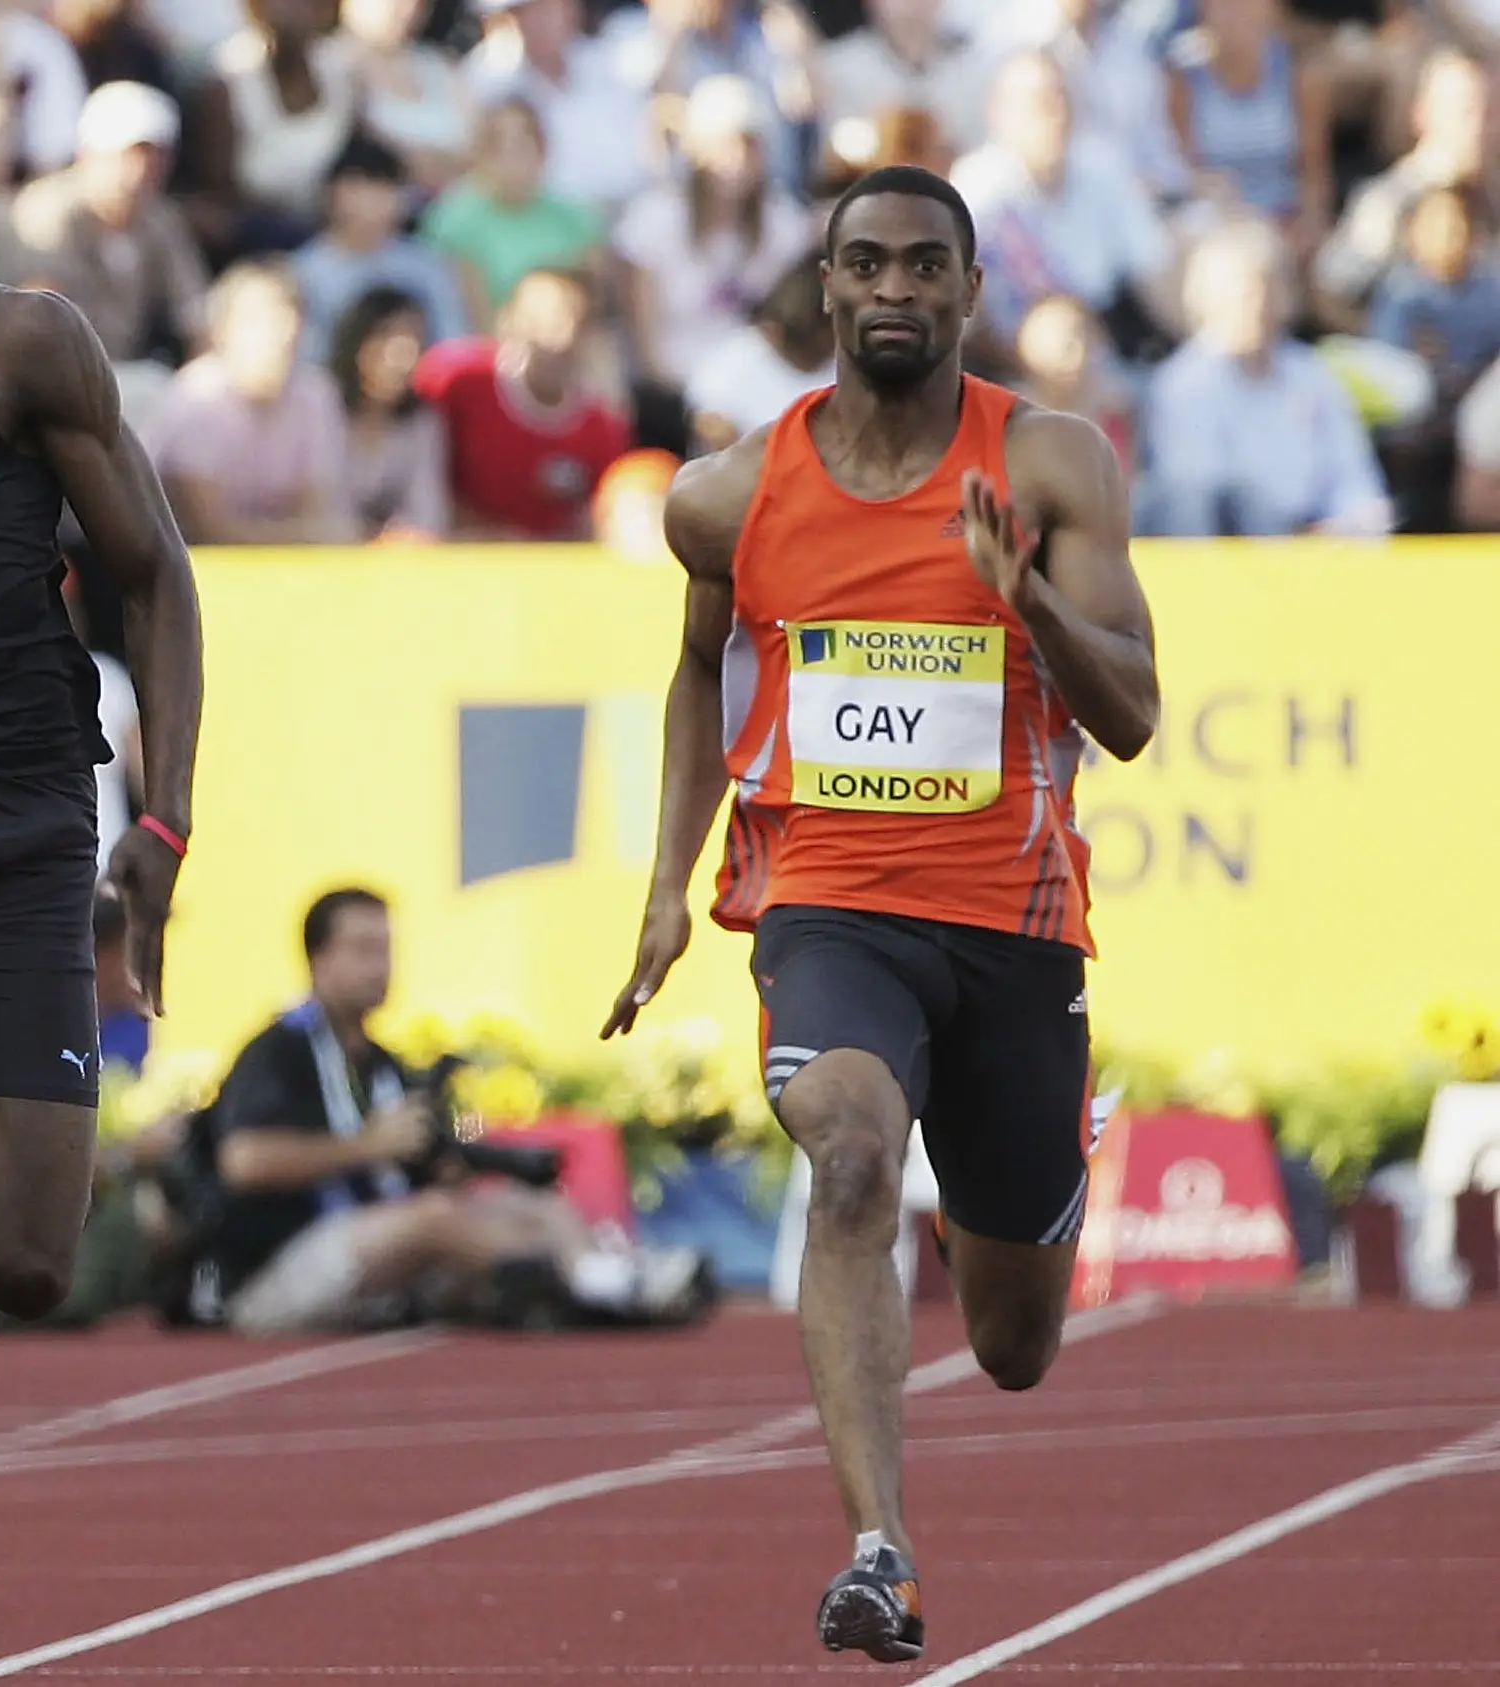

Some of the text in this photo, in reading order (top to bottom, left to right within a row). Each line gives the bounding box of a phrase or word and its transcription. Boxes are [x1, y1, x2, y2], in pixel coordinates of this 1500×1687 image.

[844, 630, 987, 654] NORWICH
[865, 652, 962, 674] UNION
[835, 702, 925, 744] GAY
[819, 771, 968, 801] LONDON
